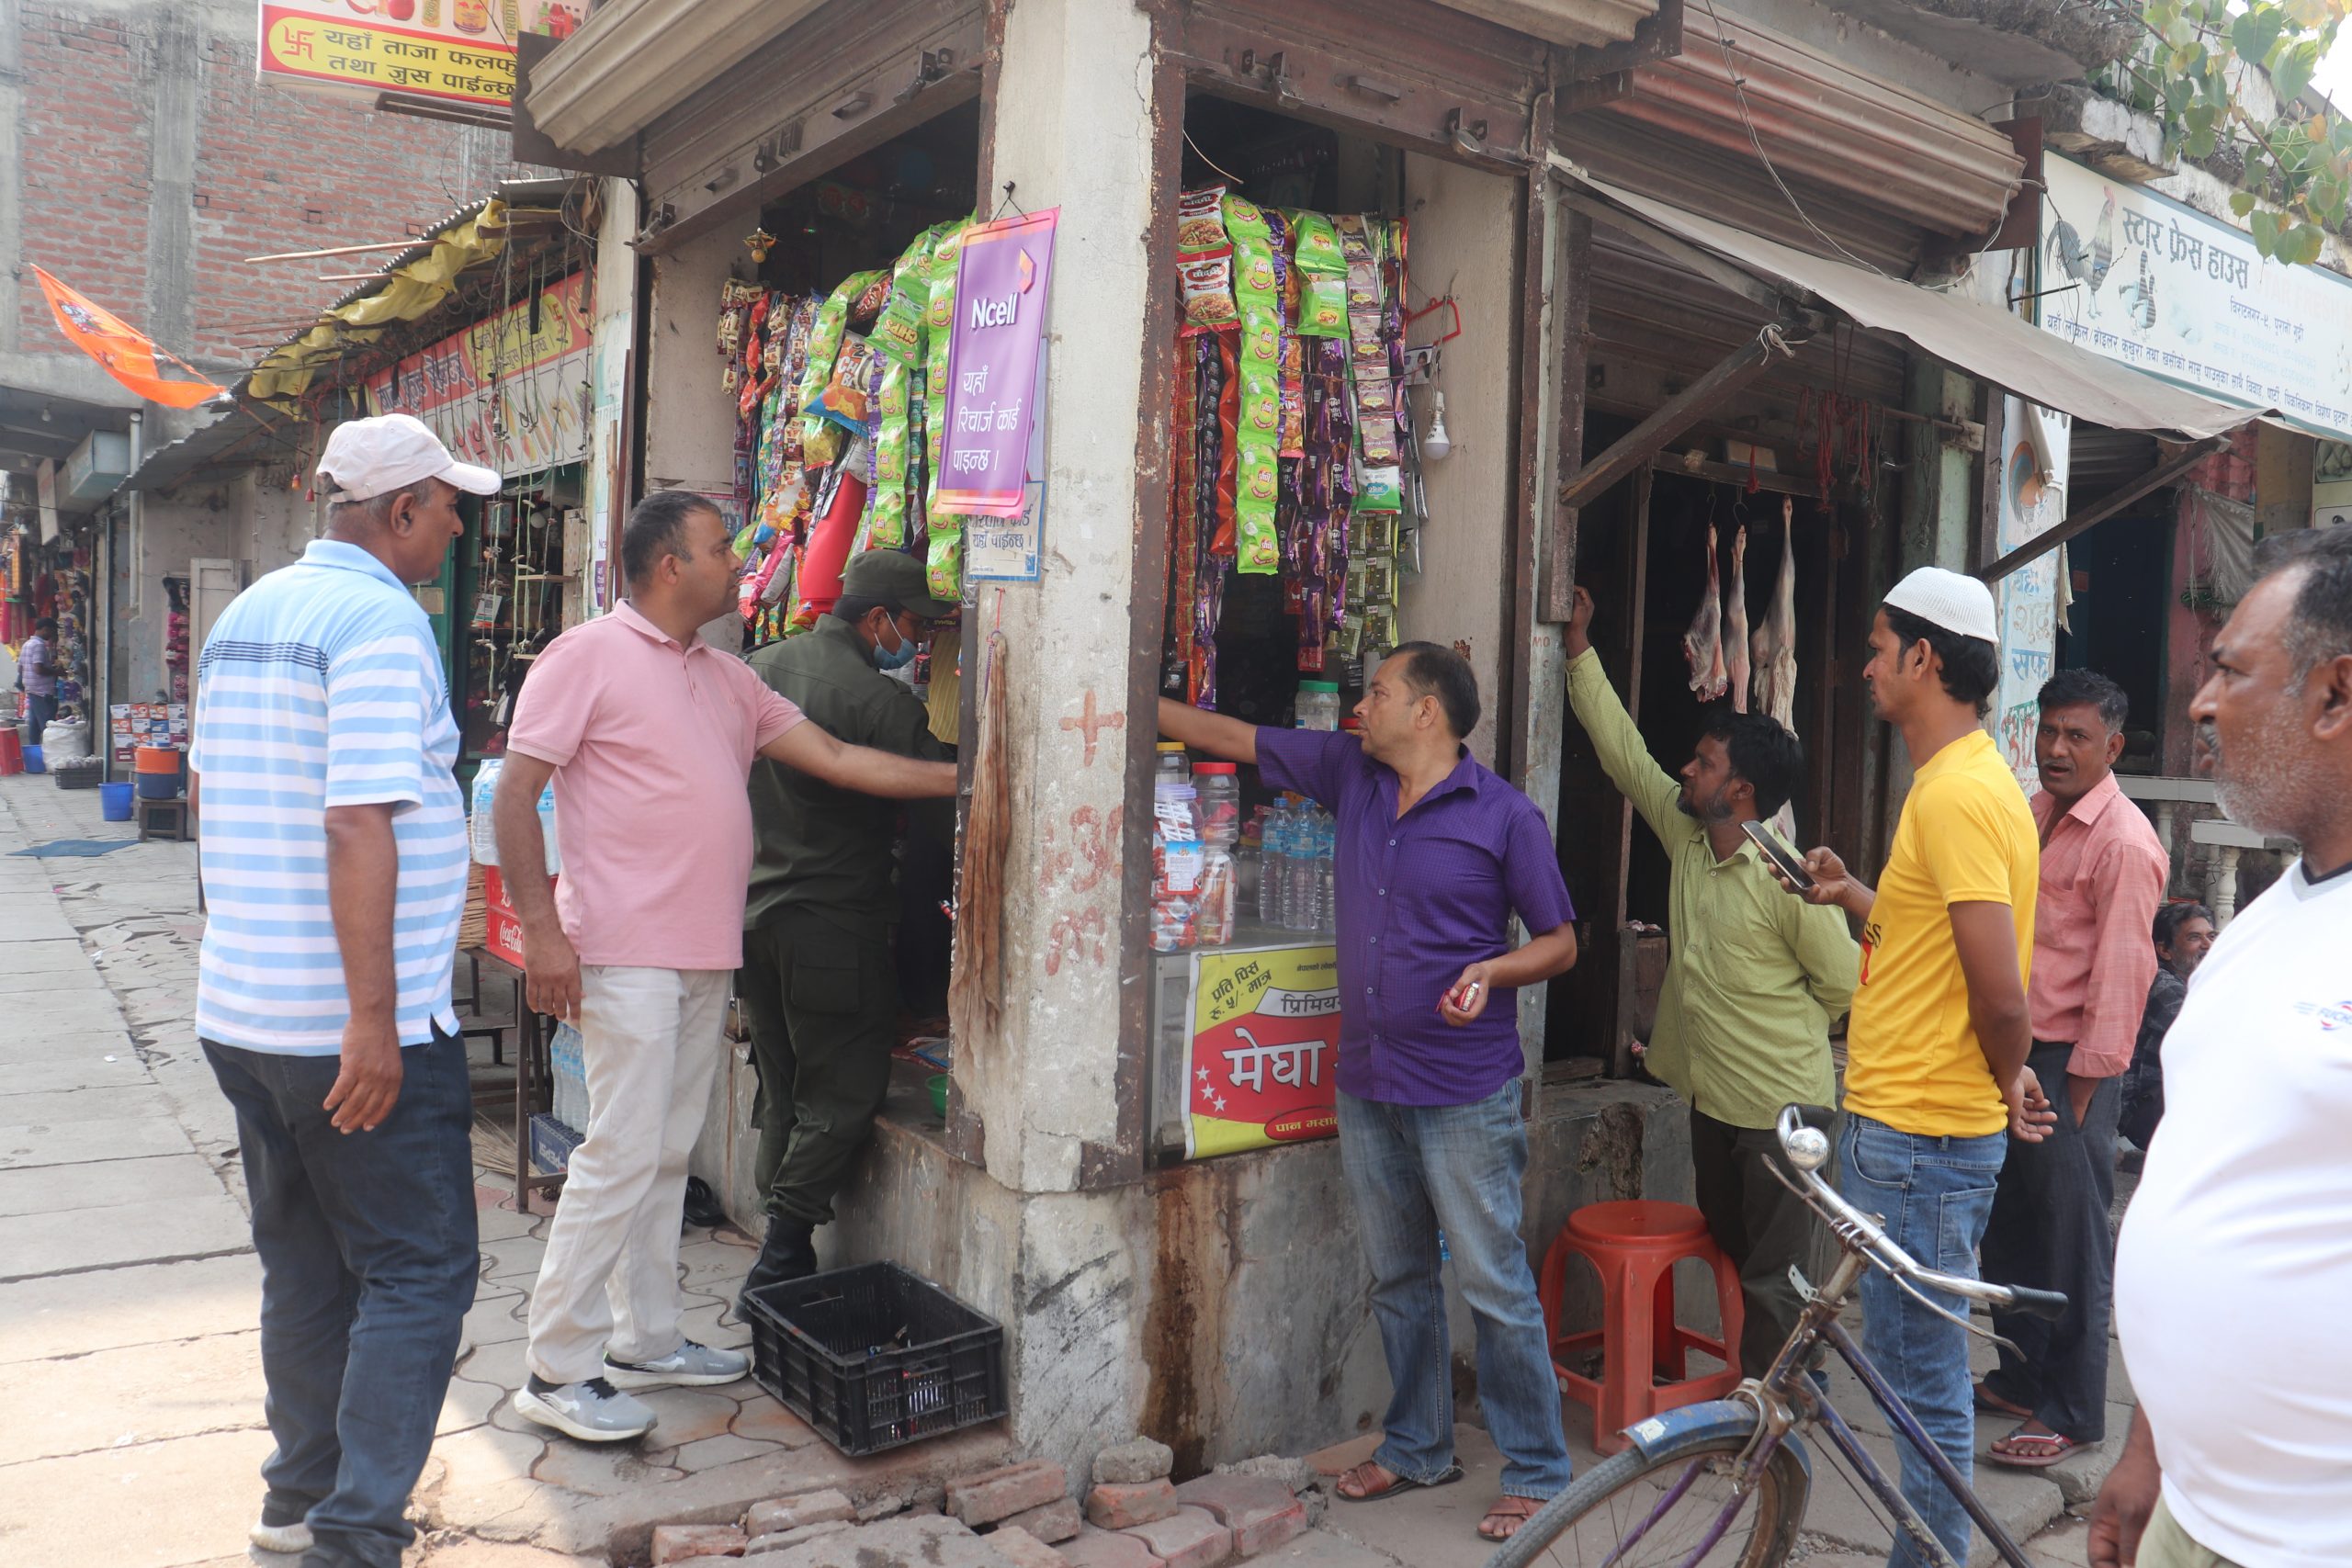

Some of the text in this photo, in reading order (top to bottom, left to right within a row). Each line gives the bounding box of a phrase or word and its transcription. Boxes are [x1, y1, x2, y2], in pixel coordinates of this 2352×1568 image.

[323, 28, 517, 76] यहाँ ताजा फलफु
[327, 54, 375, 75] तथा
[2122, 207, 2163, 256] स्टार
[2208, 244, 2249, 290] हाउस
[970, 292, 1019, 330] Ncell
[2047, 310, 2061, 333] यहाँ
[2146, 346, 2159, 362] तथा
[963, 365, 989, 396] यहाँ
[956, 399, 1022, 434] रिचार्ज कार्ड
[973, 530, 989, 548] यहाँ
[1211, 960, 1259, 1003] प्रति पिस
[1247, 969, 1272, 993] मात्र
[1281, 993, 1340, 1014] प्रिमिय
[1221, 1026, 1329, 1095] मेघा
[1275, 1122, 1302, 1133] पान
